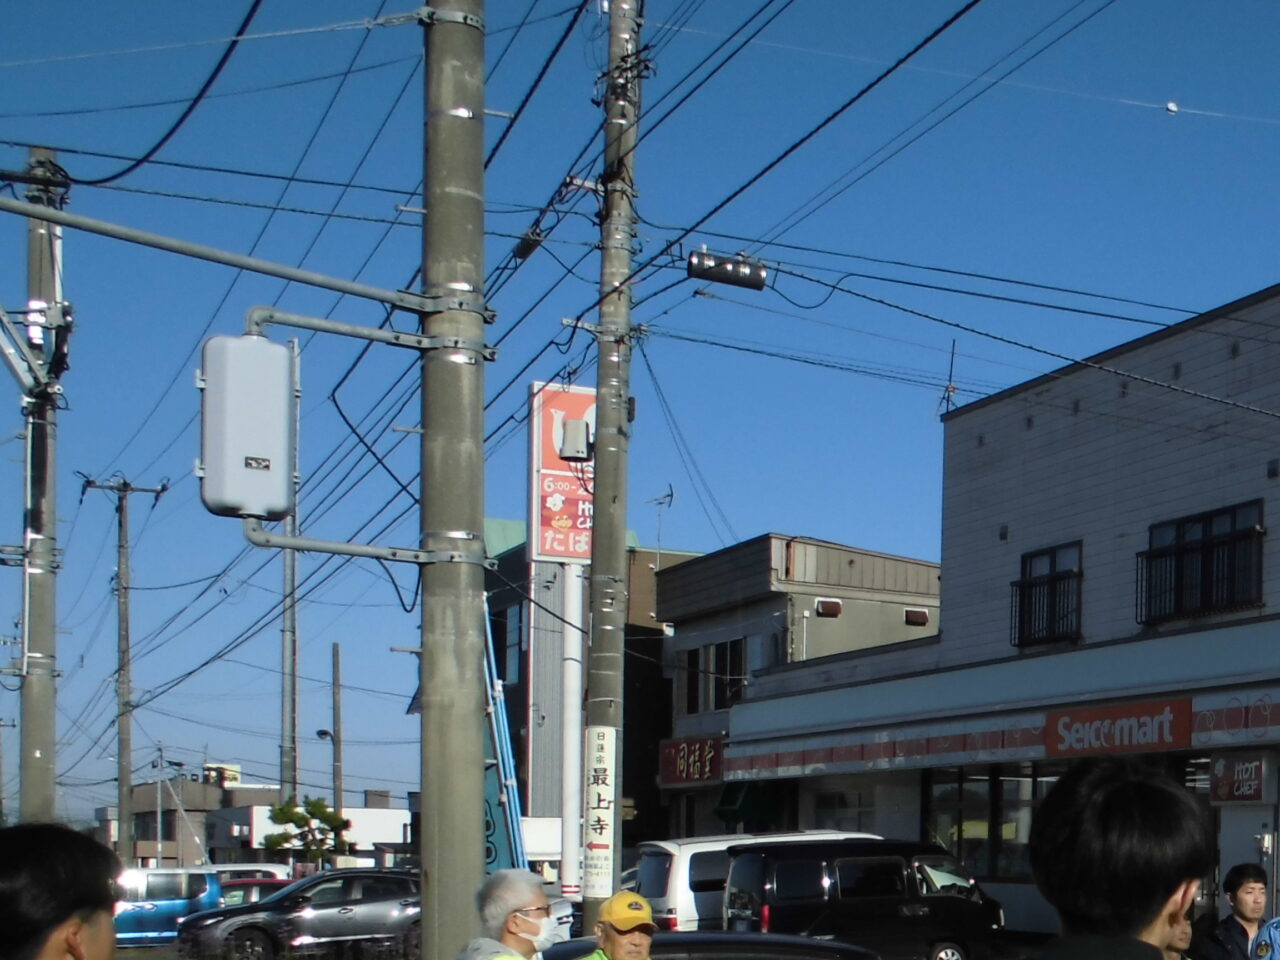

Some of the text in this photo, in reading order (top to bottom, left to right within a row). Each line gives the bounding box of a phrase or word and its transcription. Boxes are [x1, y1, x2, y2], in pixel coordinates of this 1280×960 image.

[1057, 705, 1174, 750] Seicomart
[1234, 760, 1261, 780] HOT
[590, 767, 614, 836] 最上寺
[1233, 780, 1259, 796] CHEF
